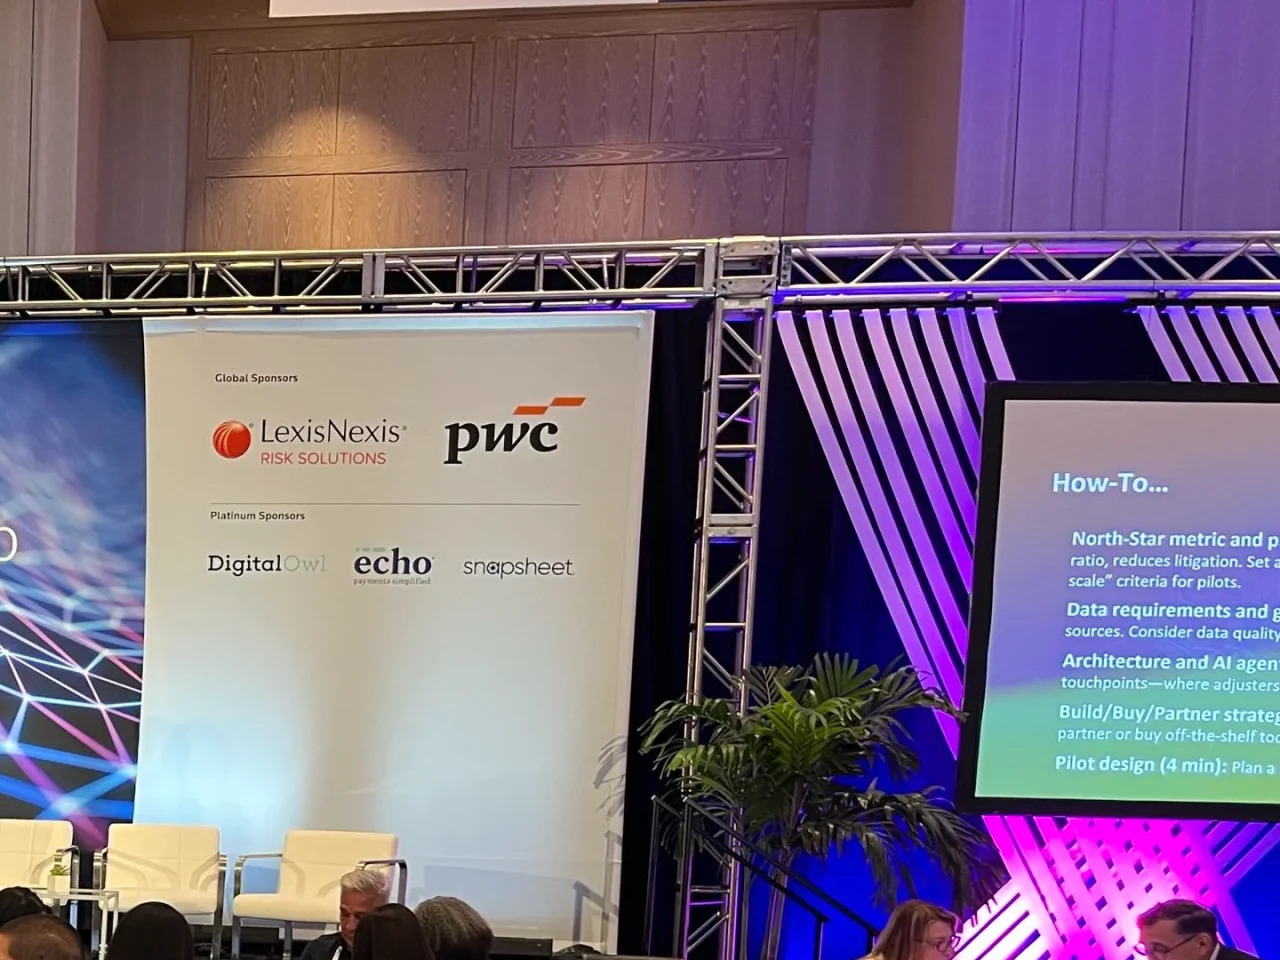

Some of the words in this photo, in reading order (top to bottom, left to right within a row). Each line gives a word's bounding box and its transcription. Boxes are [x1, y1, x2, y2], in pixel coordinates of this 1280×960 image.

[215, 373, 249, 383] Global
[251, 373, 298, 384] Sponsors
[261, 418, 401, 443] LexisNexis
[443, 420, 559, 465] pwc
[260, 452, 294, 465] RISK
[298, 452, 387, 465] SOLUTIONS
[1052, 471, 1169, 493] How-To...
[210, 511, 256, 520] Platinum
[258, 511, 306, 522] Sponsors
[1072, 530, 1166, 547] North-Star
[1169, 531, 1226, 547] metric
[1229, 531, 1264, 547] and
[208, 554, 326, 577] DigitalOwl
[354, 547, 433, 575] echo
[1070, 554, 1109, 568] ratio,
[1113, 554, 1171, 567] reduces
[1174, 554, 1243, 570] litigation.
[1246, 555, 1270, 568] Set
[1116, 574, 1168, 588] criteria
[1172, 574, 1193, 588] for
[1196, 575, 1242, 591] pilots.
[1066, 602, 1108, 617] Data
[1112, 602, 1231, 620] requirements
[1235, 603, 1269, 618] and
[1064, 626, 1124, 638] sources.
[1128, 625, 1193, 639] Consider
[1196, 626, 1229, 639] data
[1232, 626, 1280, 642] quality
[1062, 653, 1171, 669] Architecture
[1175, 654, 1208, 670] and
[1212, 655, 1232, 670] AI
[1236, 657, 1280, 673] agen
[1213, 677, 1280, 693] adjusters
[1058, 704, 1220, 723] Build/Buy/Partner
[1057, 729, 1112, 745] partner
[1115, 731, 1131, 742] or
[1134, 728, 1162, 745] buy
[1165, 728, 1258, 743] off-the-shelf
[1054, 756, 1096, 771] Pilot
[1098, 756, 1156, 775] design
[1159, 757, 1178, 774] (4
[1181, 757, 1228, 776] min):
[1231, 760, 1263, 774] Plan
[1266, 764, 1275, 775] a
